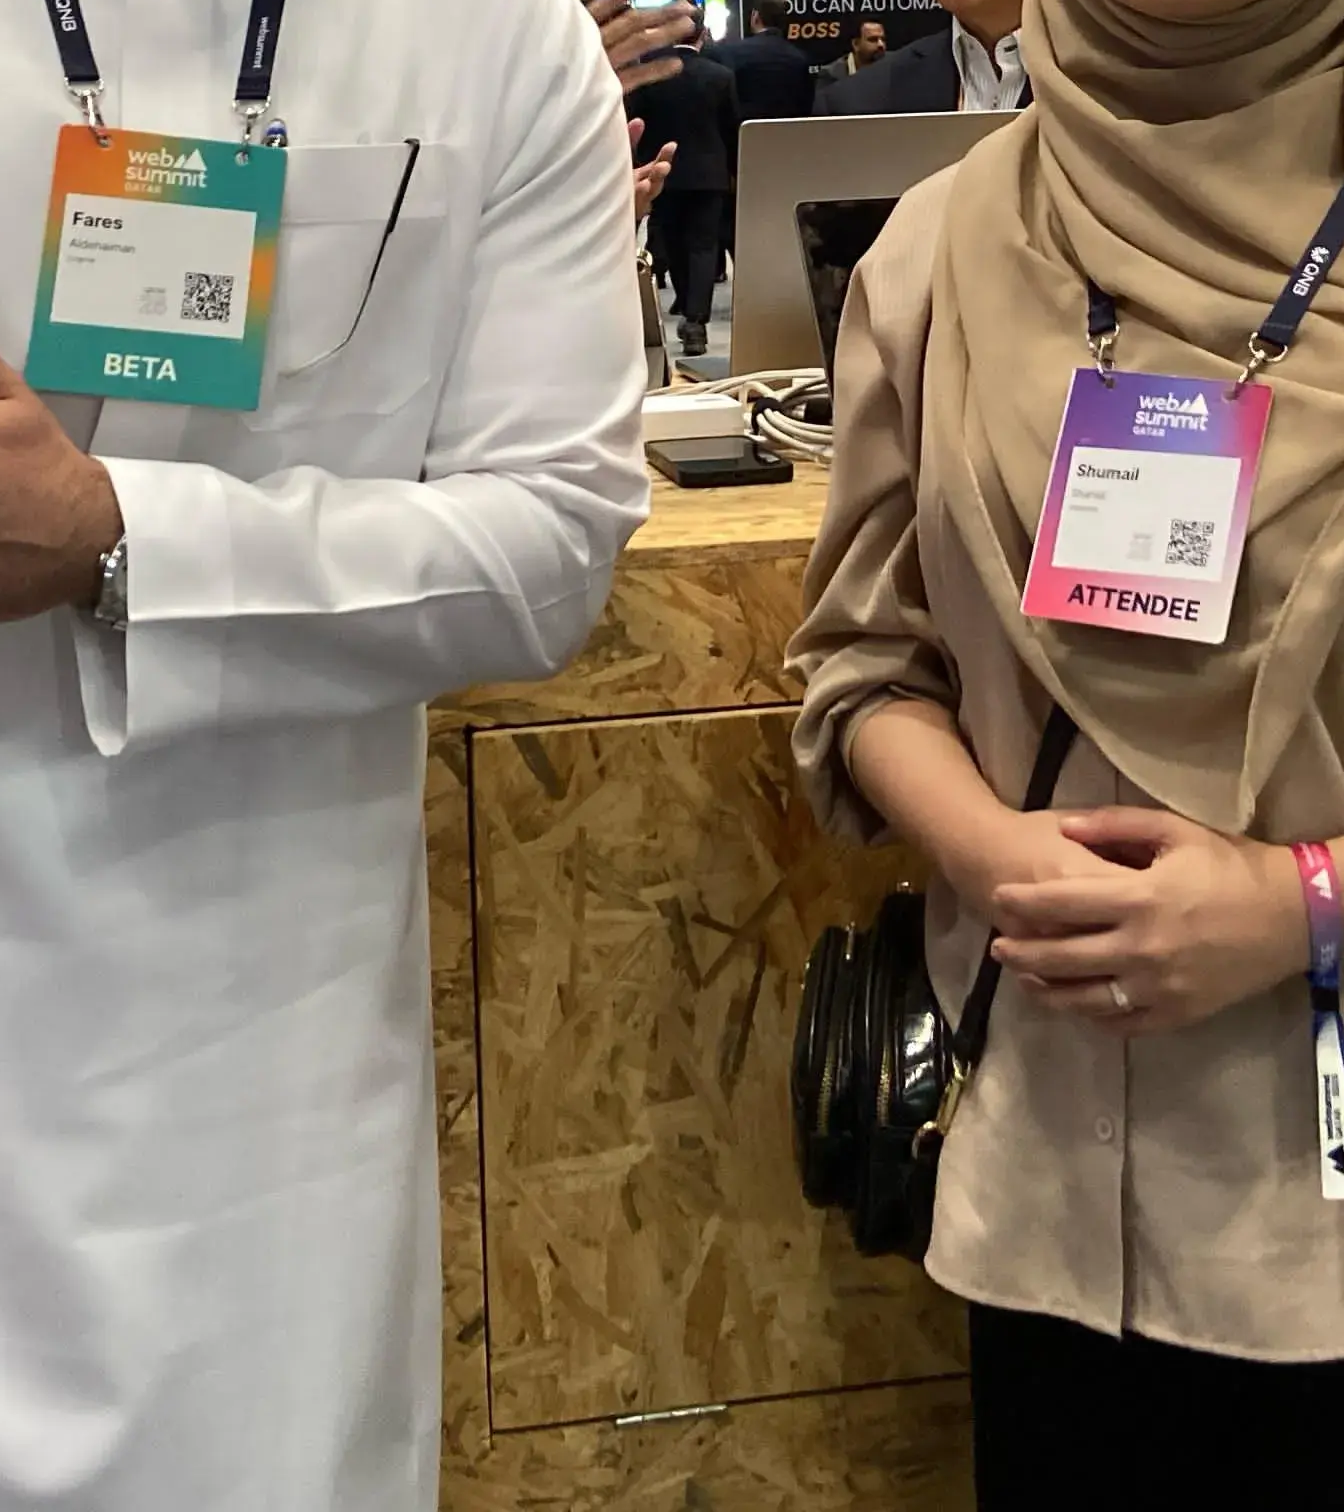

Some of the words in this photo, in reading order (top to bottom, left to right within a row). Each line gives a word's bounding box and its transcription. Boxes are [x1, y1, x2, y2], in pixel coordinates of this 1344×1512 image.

[787, 22, 841, 39] BOSS
[128, 147, 174, 168] web
[125, 166, 207, 188] summit
[72, 211, 123, 229] Fares
[1292, 262, 1320, 297] QNB
[103, 353, 177, 382] BETA
[1139, 392, 1179, 411] web
[1135, 411, 1208, 431] summit
[1076, 463, 1140, 481] Shumail
[1067, 583, 1201, 622] ATTENDEE
